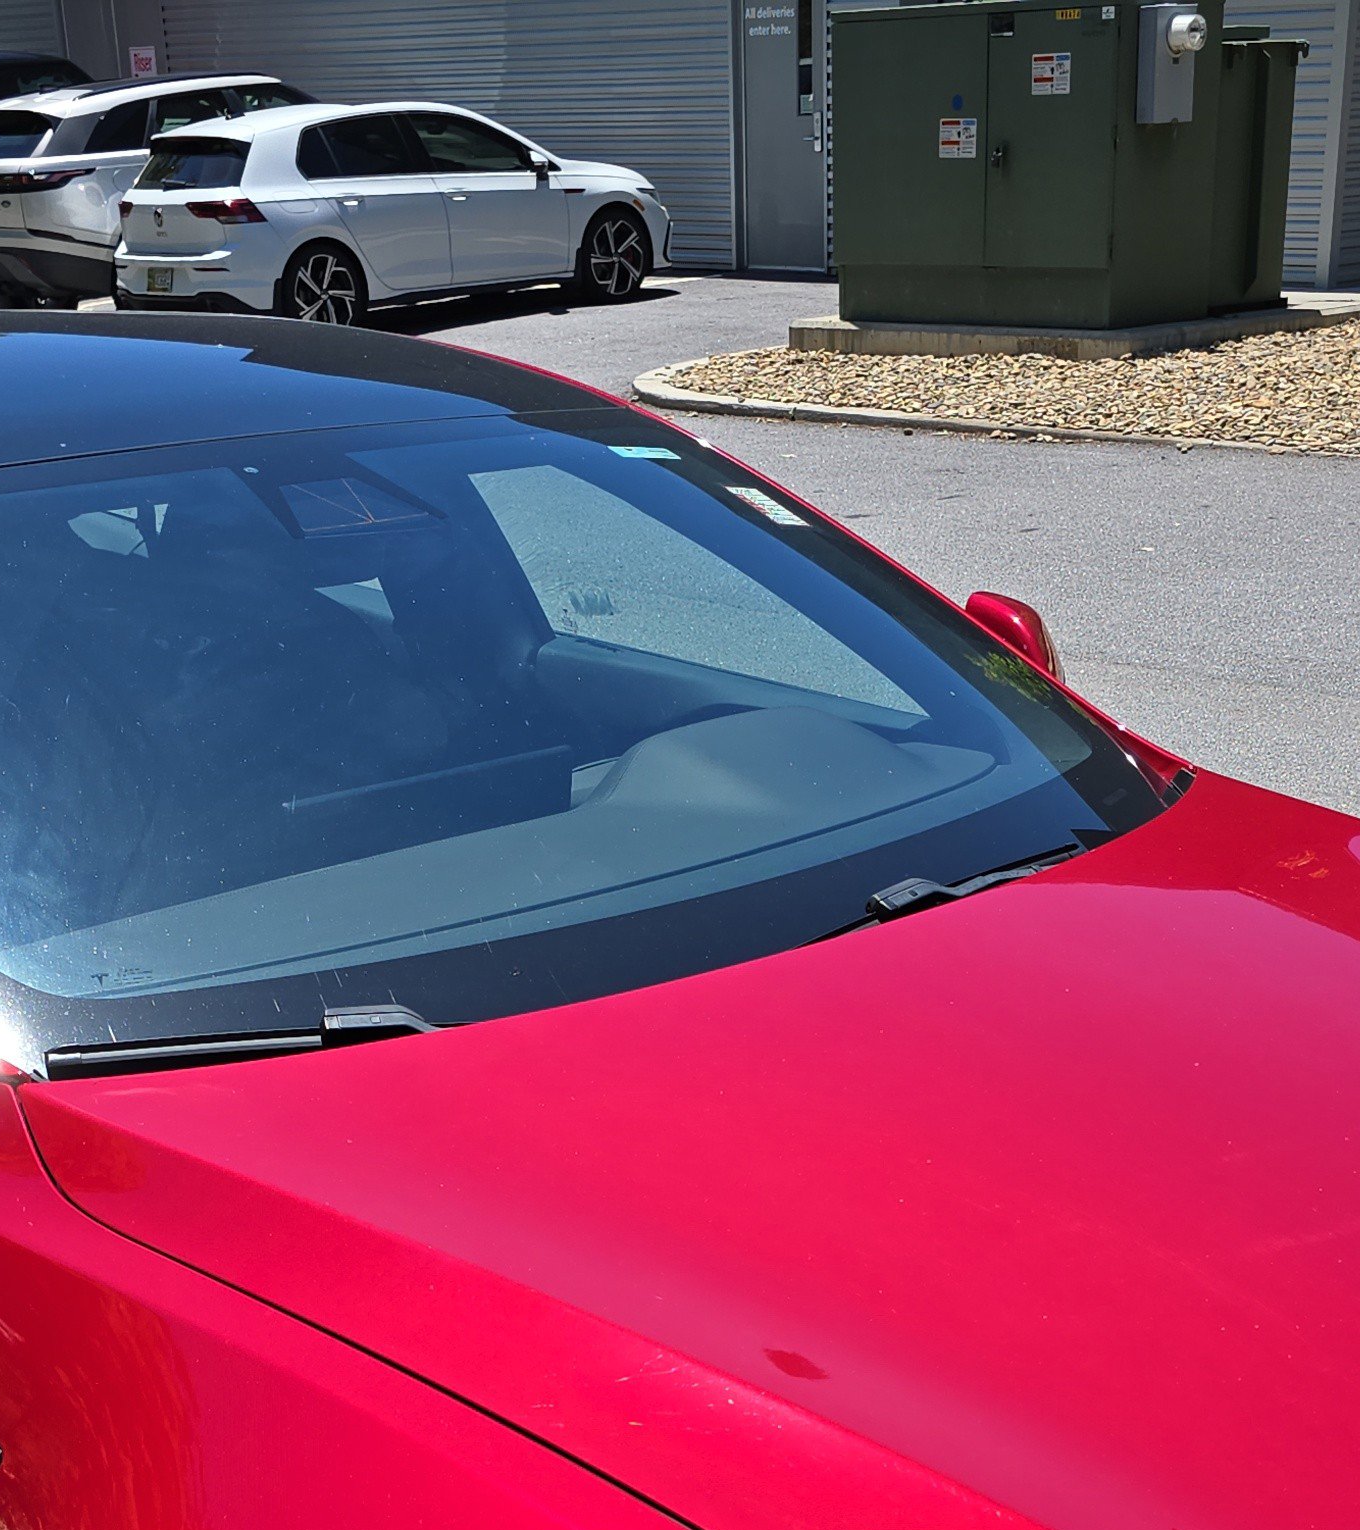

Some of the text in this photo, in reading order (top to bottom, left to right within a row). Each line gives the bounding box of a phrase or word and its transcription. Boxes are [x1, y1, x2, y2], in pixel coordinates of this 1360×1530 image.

[745, 6, 795, 19] All deliveries
[749, 23, 791, 36] enter here.
